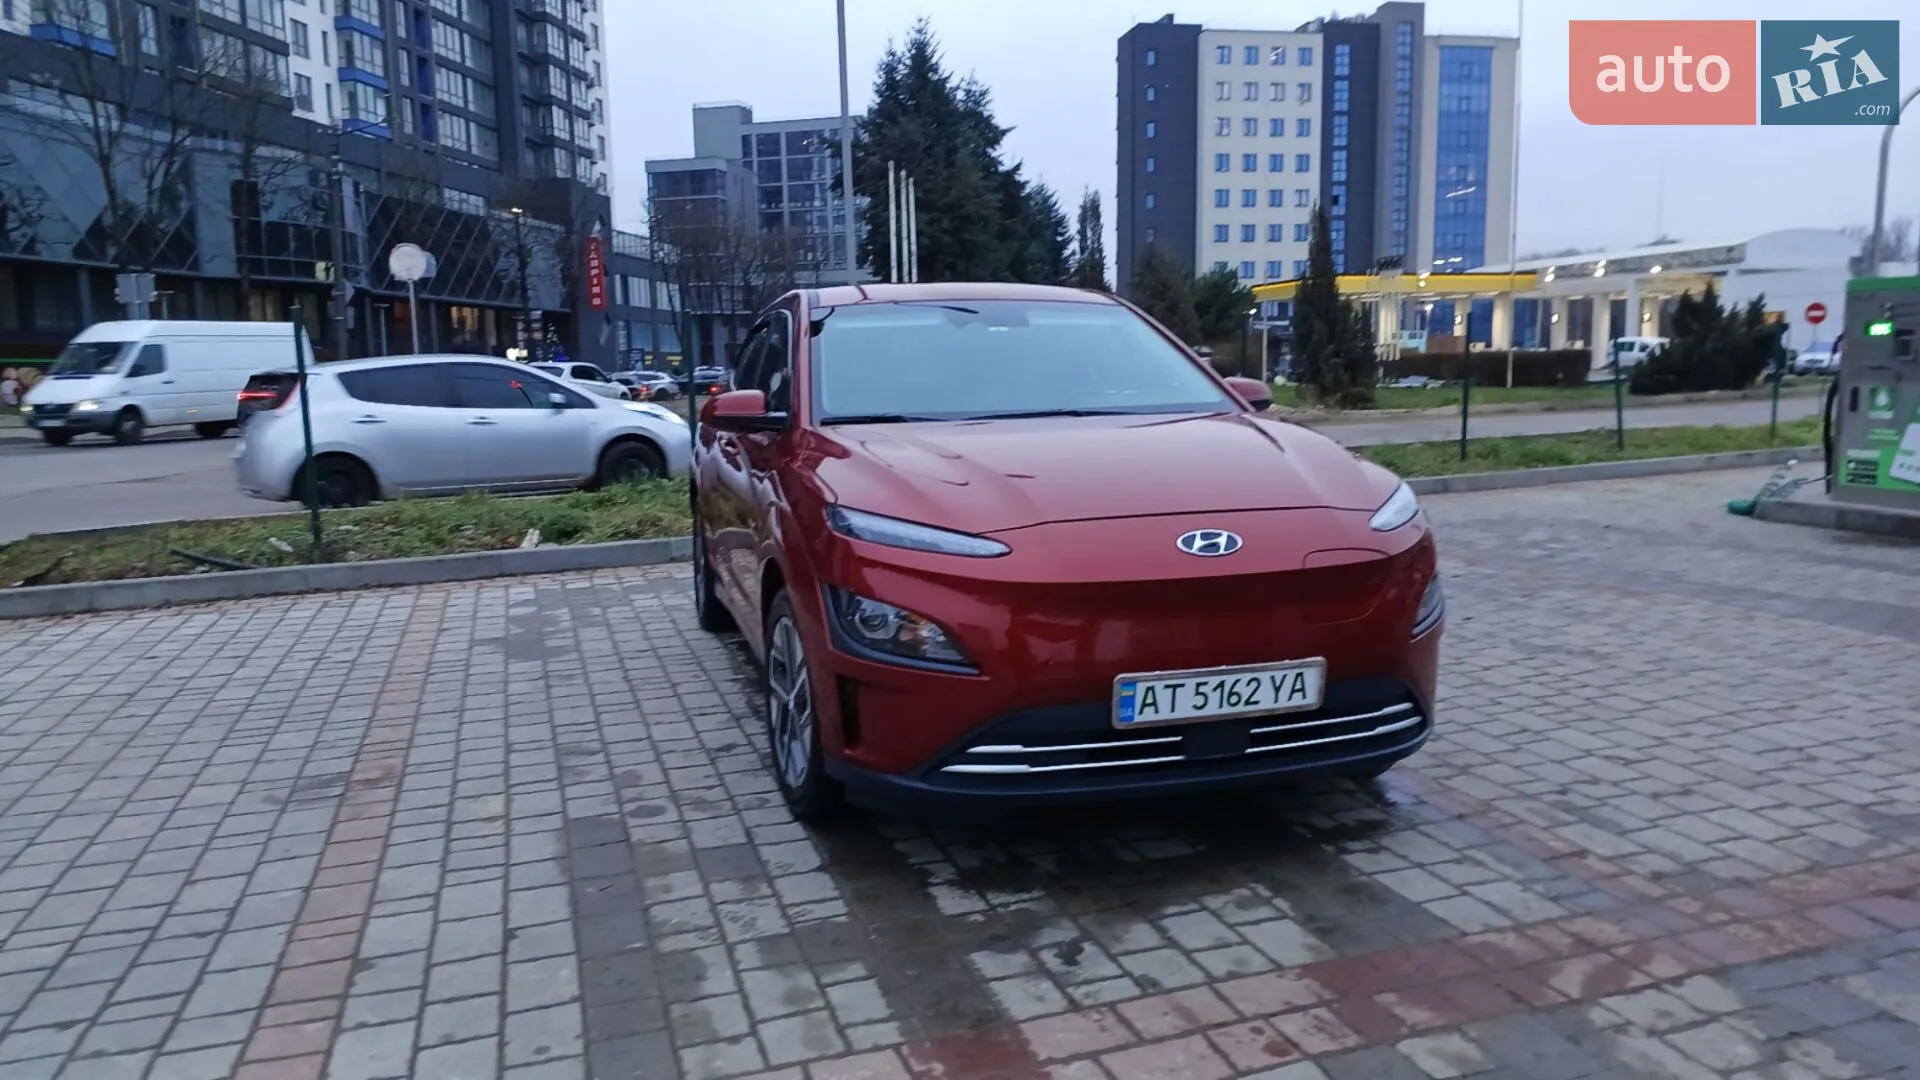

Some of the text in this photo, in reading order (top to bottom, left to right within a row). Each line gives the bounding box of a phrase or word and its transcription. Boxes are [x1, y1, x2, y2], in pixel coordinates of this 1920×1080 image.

[1138, 671, 1307, 715] AT 5162 YA
